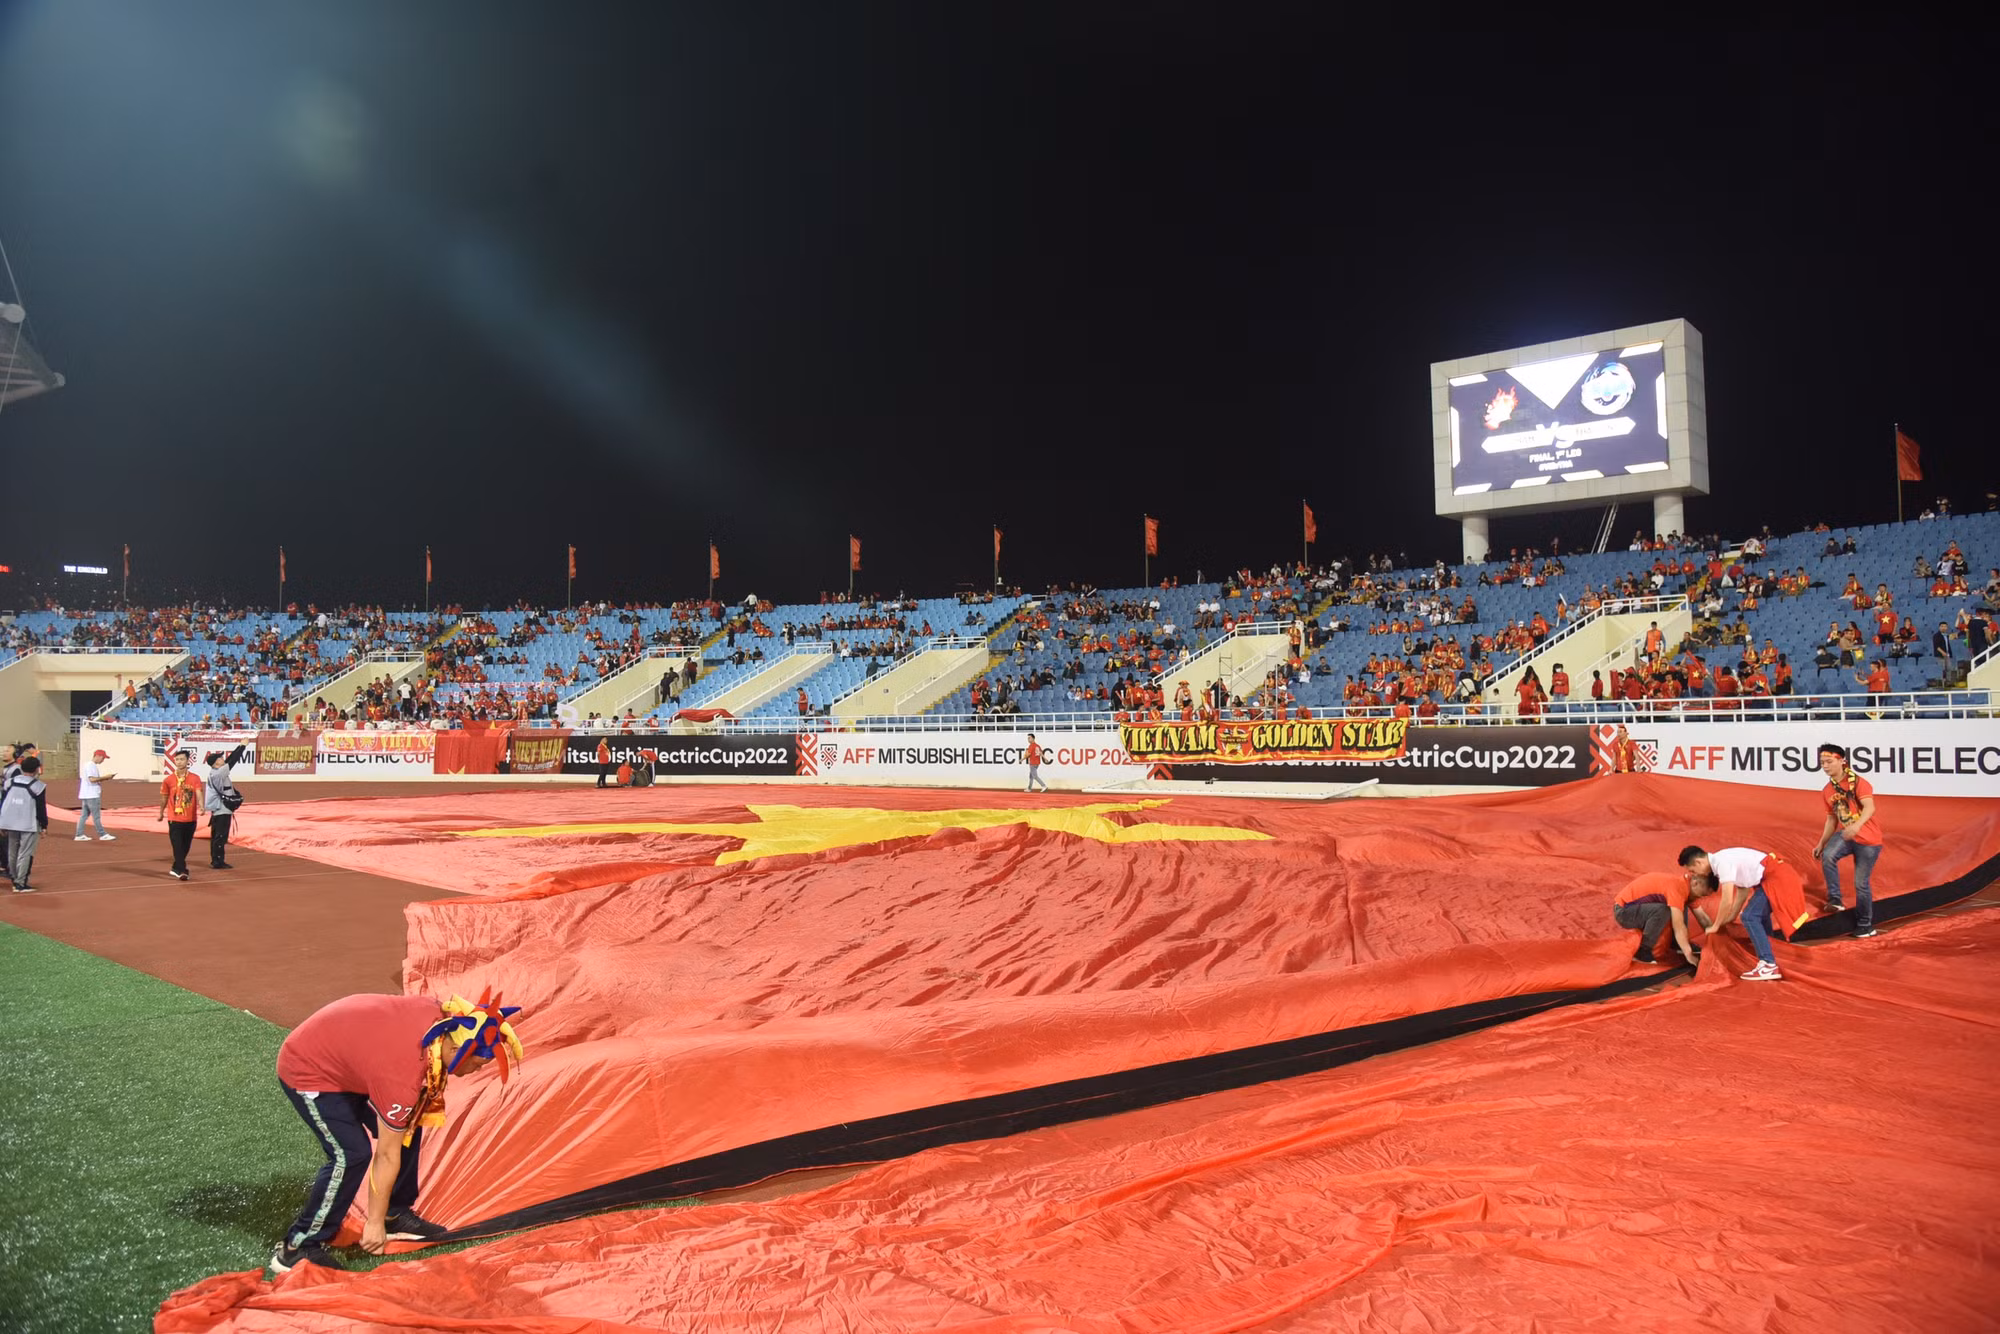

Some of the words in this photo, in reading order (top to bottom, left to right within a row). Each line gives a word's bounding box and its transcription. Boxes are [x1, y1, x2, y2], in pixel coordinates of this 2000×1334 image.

[1120, 724, 1218, 752] VIETNAM
[1252, 722, 1337, 751] GOLDEN
[1342, 719, 1403, 749] STAR
[843, 748, 875, 764] AFF
[878, 748, 969, 764] MITSUBISHI
[972, 747, 1054, 766] ELECTC
[1057, 748, 1097, 766] CUP
[1668, 746, 1725, 770] AFF
[1731, 746, 1905, 774] MITSUISHI
[386, 1103, 413, 1123] 27
